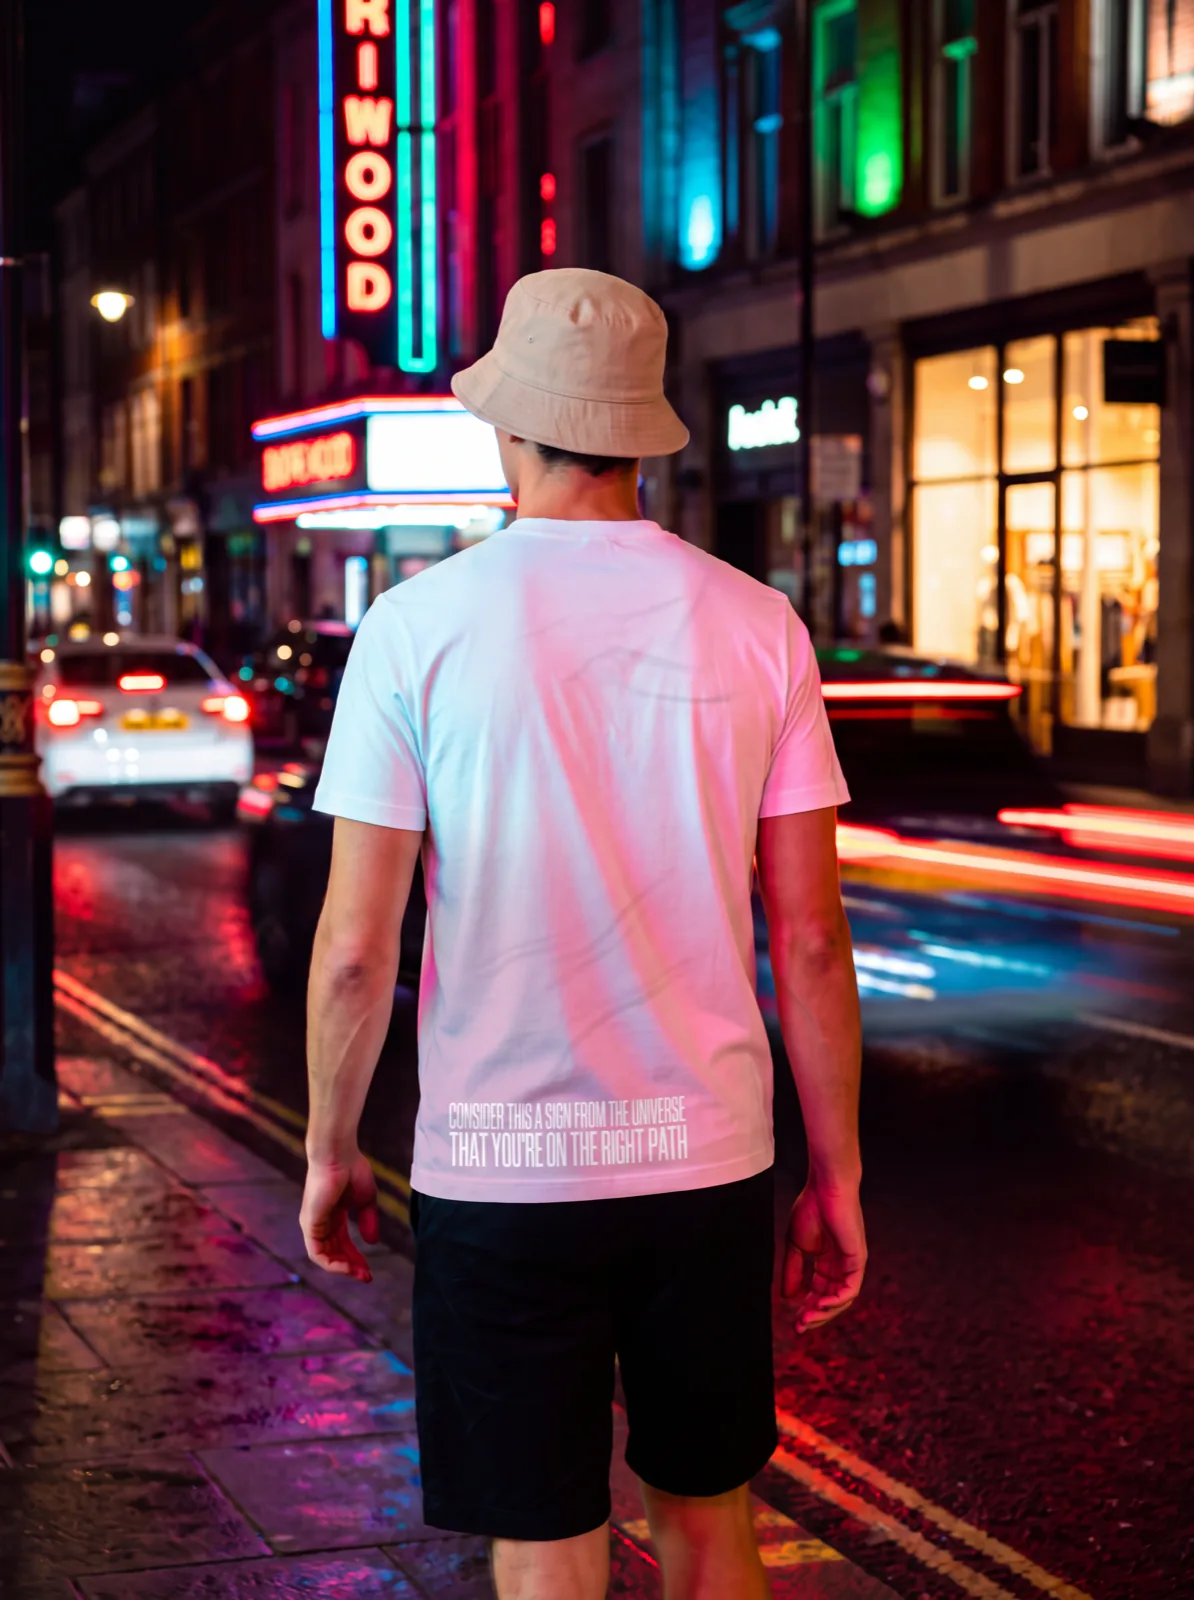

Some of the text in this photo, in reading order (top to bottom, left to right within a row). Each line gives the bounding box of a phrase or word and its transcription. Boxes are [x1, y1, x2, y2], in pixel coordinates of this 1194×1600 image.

[449, 1095, 686, 1130] CONSIDER THIS A SIGN FROM THE UNIVERSE
[449, 1124, 688, 1168] THAT YOU'RE ON THE RIGHT PATH
